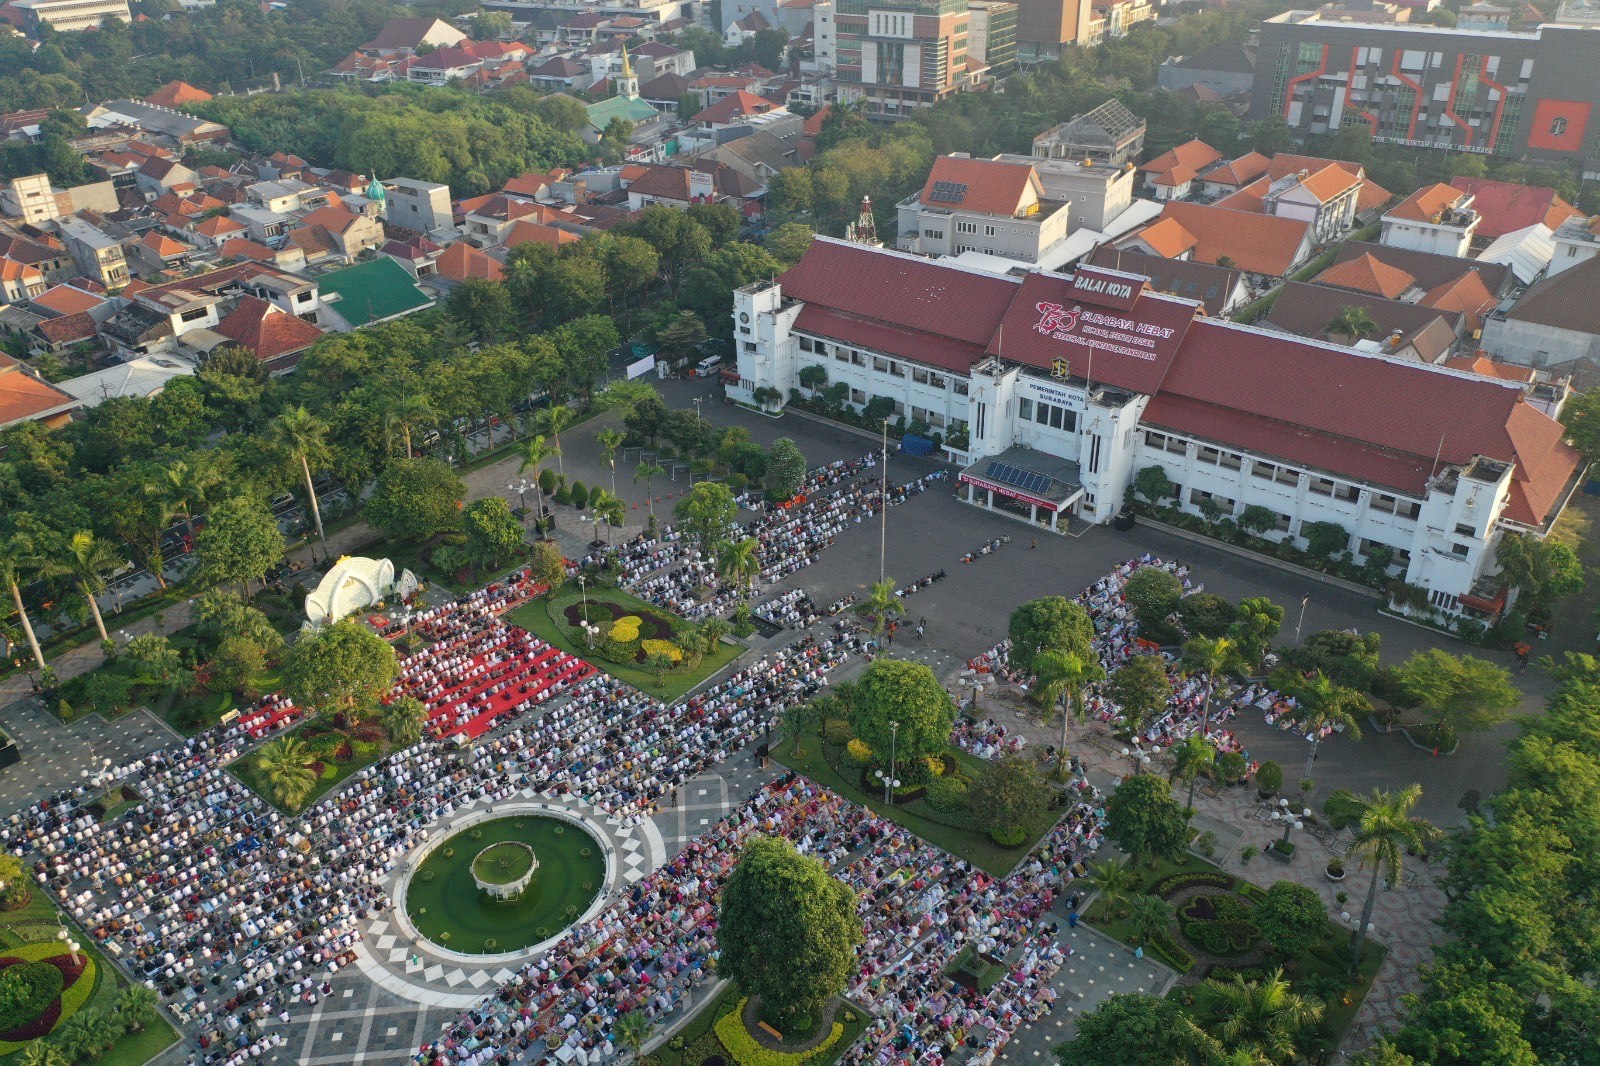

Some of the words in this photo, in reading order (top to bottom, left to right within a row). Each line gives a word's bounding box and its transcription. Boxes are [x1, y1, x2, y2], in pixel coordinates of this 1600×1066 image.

[1433, 142, 1453, 150] KOTA
[1458, 144, 1494, 154] SURABAYA
[1074, 276, 1106, 294] BALAI
[1106, 282, 1132, 299] KOTA
[1080, 311, 1134, 331] SURABAYA
[1135, 322, 1175, 339] HEBAT
[1030, 384, 1066, 398] PEMERINTAH
[1068, 393, 1084, 403] KOTA
[1039, 393, 1073, 407] SURABAYA
[969, 479, 998, 492] SURABAYA
[998, 488, 1017, 498] HEBAT
